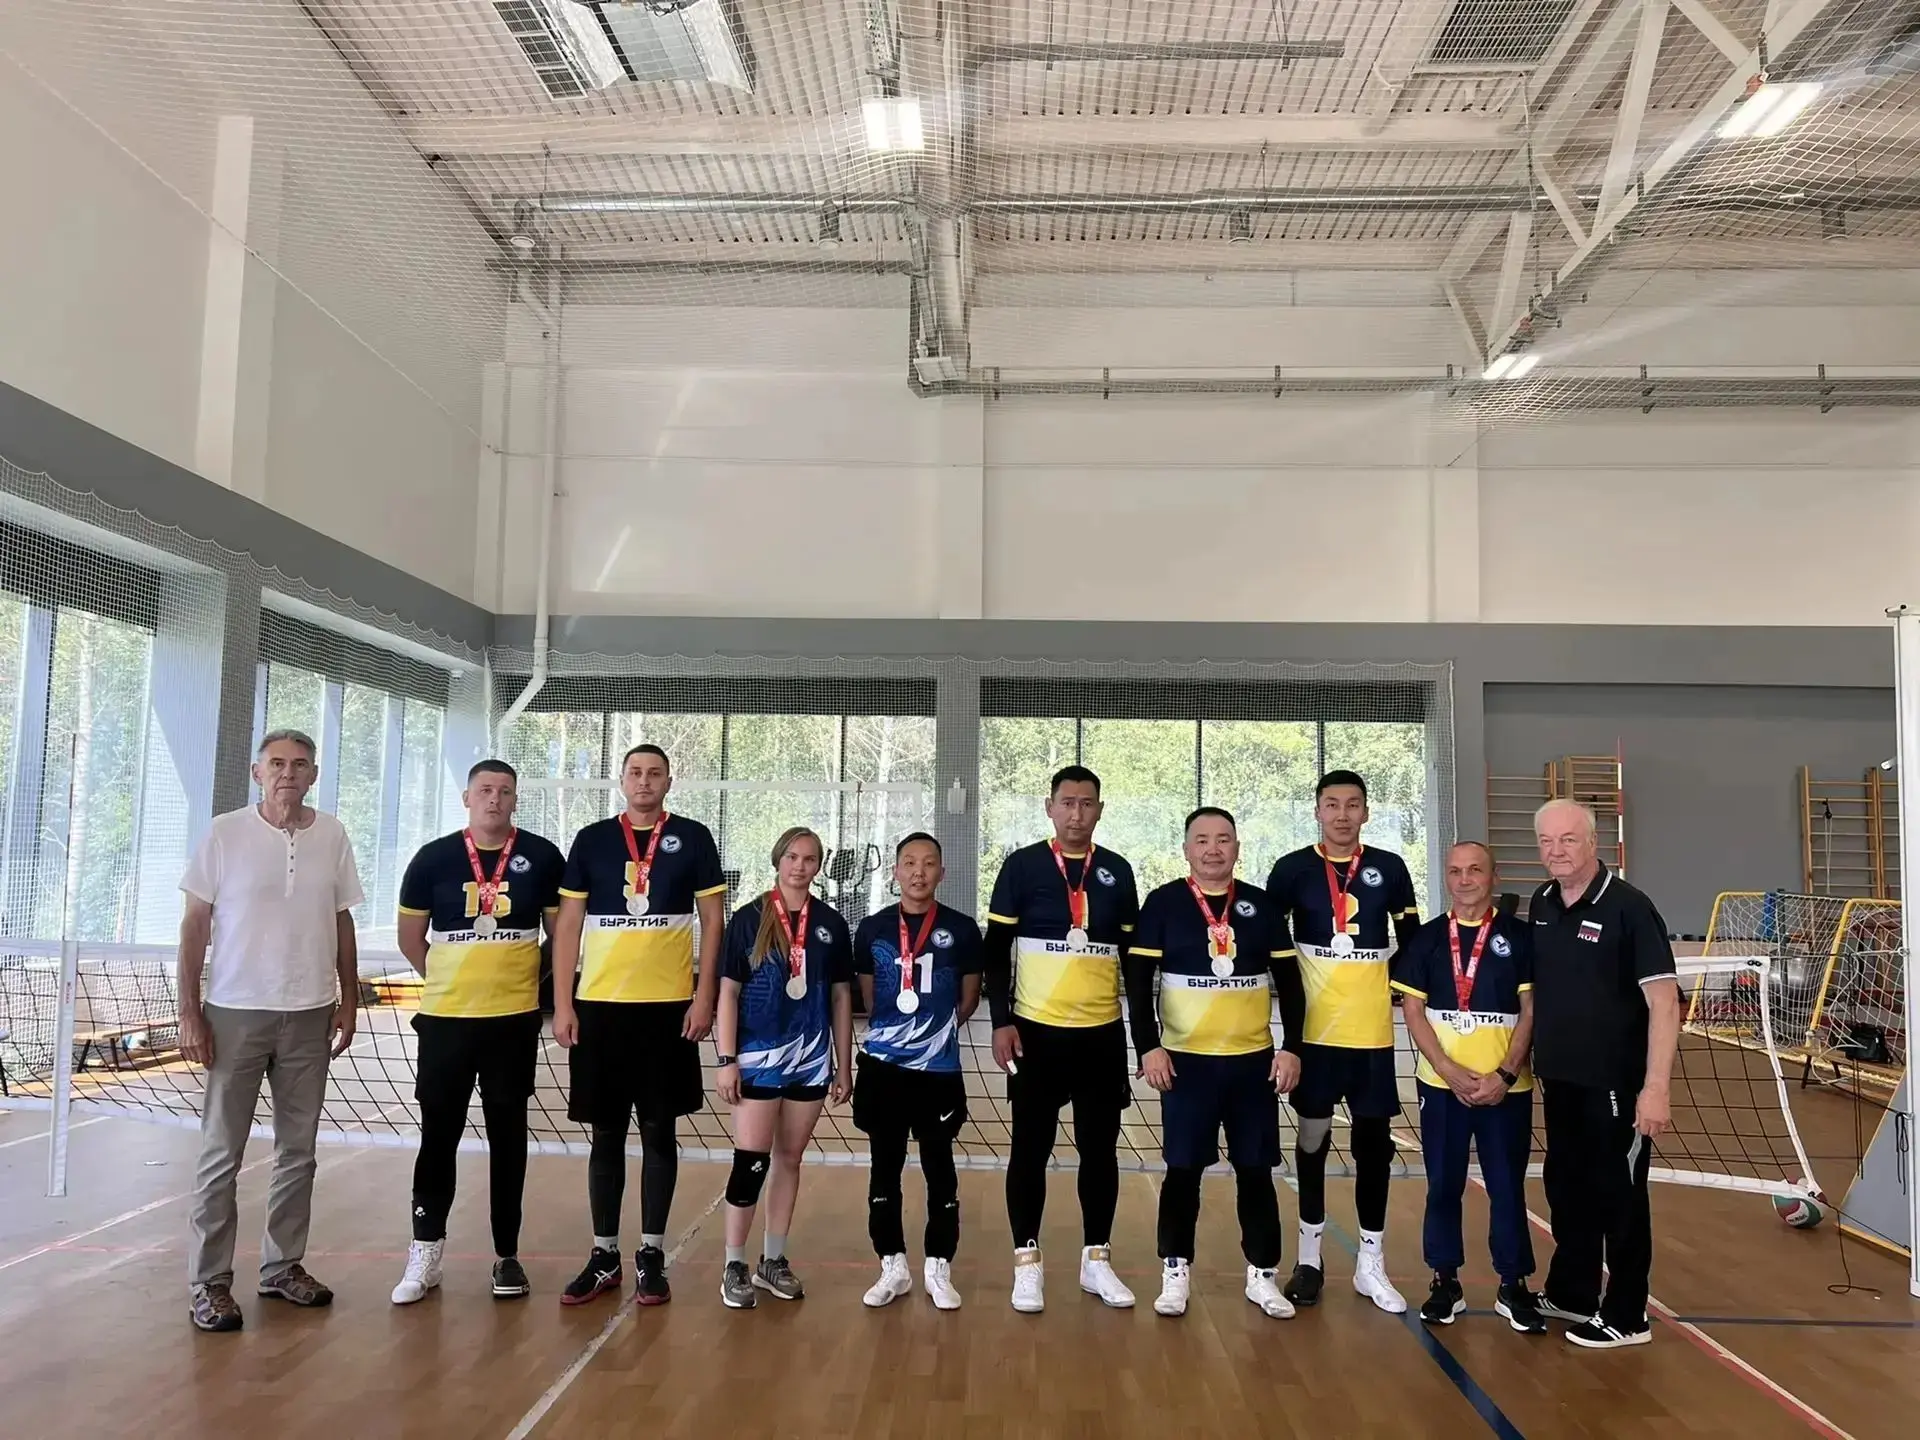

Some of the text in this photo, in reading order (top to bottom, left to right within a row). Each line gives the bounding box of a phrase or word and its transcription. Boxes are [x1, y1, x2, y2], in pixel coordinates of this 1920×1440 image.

[1332, 892, 1360, 936] 2
[599, 917, 669, 927] БУРЯТИЯ
[1577, 932, 1599, 943] RUS
[1045, 942, 1111, 955] БУТИЯ
[1187, 978, 1258, 988] БУРЯТИЯ
